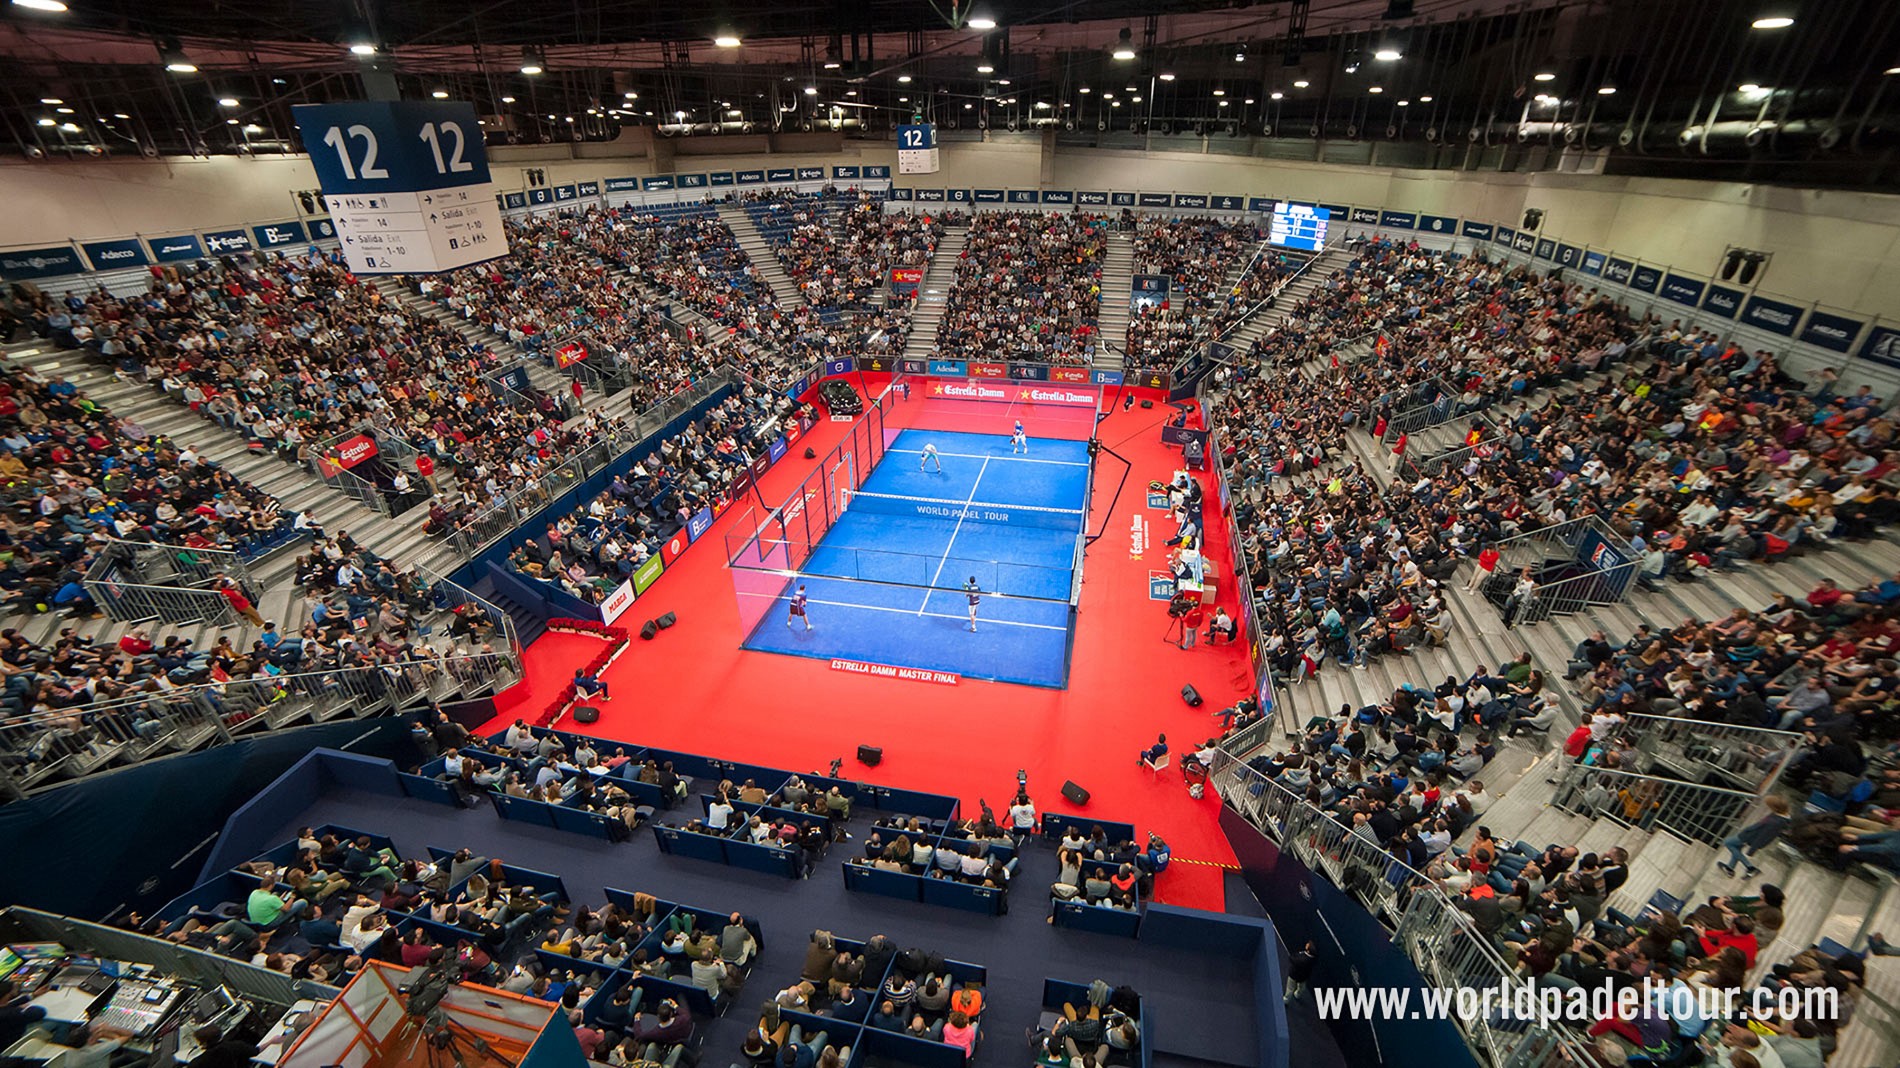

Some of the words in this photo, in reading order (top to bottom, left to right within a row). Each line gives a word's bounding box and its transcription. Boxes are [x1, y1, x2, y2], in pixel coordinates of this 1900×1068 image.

[904, 130, 923, 147] 12
[324, 124, 389, 179] 12
[419, 121, 473, 174] 12
[459, 192, 467, 200] 14
[442, 209, 463, 219] Salida
[466, 207, 478, 216] Exit
[377, 218, 388, 227] 14
[358, 234, 383, 243] Salida
[387, 234, 402, 243] Exit
[101, 250, 136, 260] Adecco
[1812, 324, 1848, 338] HEAD
[944, 384, 977, 396] Estrella
[977, 386, 1005, 398] Damm
[1031, 389, 1064, 401] Estrella
[1065, 392, 1094, 403] Damm
[340, 442, 371, 460] Estrella
[916, 505, 949, 517] WORLD
[951, 509, 980, 519] PADEL
[984, 511, 1009, 521] TOUR
[608, 592, 628, 614] MARCA
[831, 660, 869, 673] ESTRELLA
[870, 665, 897, 677] DAMM
[898, 668, 932, 681] MASTER
[933, 672, 957, 684] FINAL
